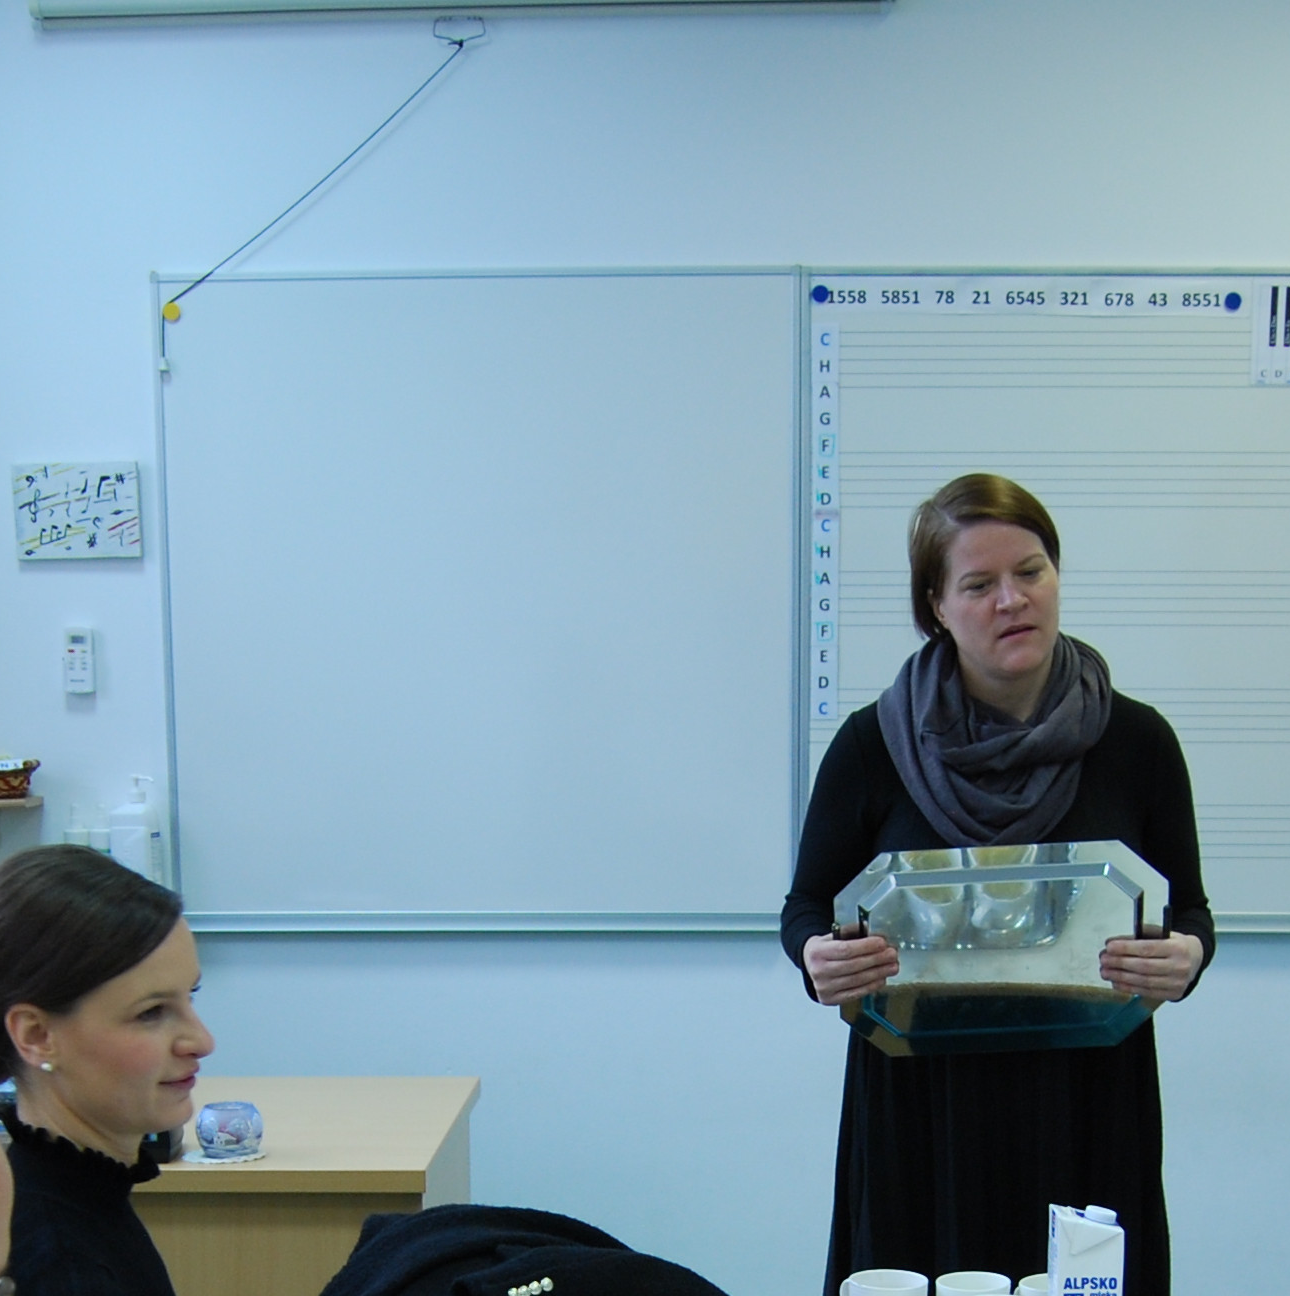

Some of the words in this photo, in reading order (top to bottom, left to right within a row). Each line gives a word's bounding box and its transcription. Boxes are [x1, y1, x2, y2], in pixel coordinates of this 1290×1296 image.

[827, 289, 867, 305] 1558
[881, 290, 920, 305] 5851
[935, 290, 955, 305] 78
[972, 290, 991, 305] 21
[1005, 290, 1046, 306] 6545
[1060, 291, 1089, 306] 321
[1104, 292, 1135, 307] 678
[1147, 292, 1168, 307] 43
[1181, 292, 1221, 308] 8551
[820, 332, 830, 346] C
[819, 359, 831, 373] H
[819, 385, 831, 399] A
[819, 411, 831, 425] G
[821, 438, 830, 453] F
[821, 465, 830, 479] E
[820, 492, 831, 506] D
[820, 518, 831, 533] C
[819, 545, 831, 559] H
[819, 571, 831, 585] A
[818, 598, 830, 612] G
[820, 624, 829, 638] F
[819, 649, 828, 663] E
[818, 675, 830, 689] D
[818, 701, 828, 716] C
[1063, 1277, 1118, 1290] ALPSKO
